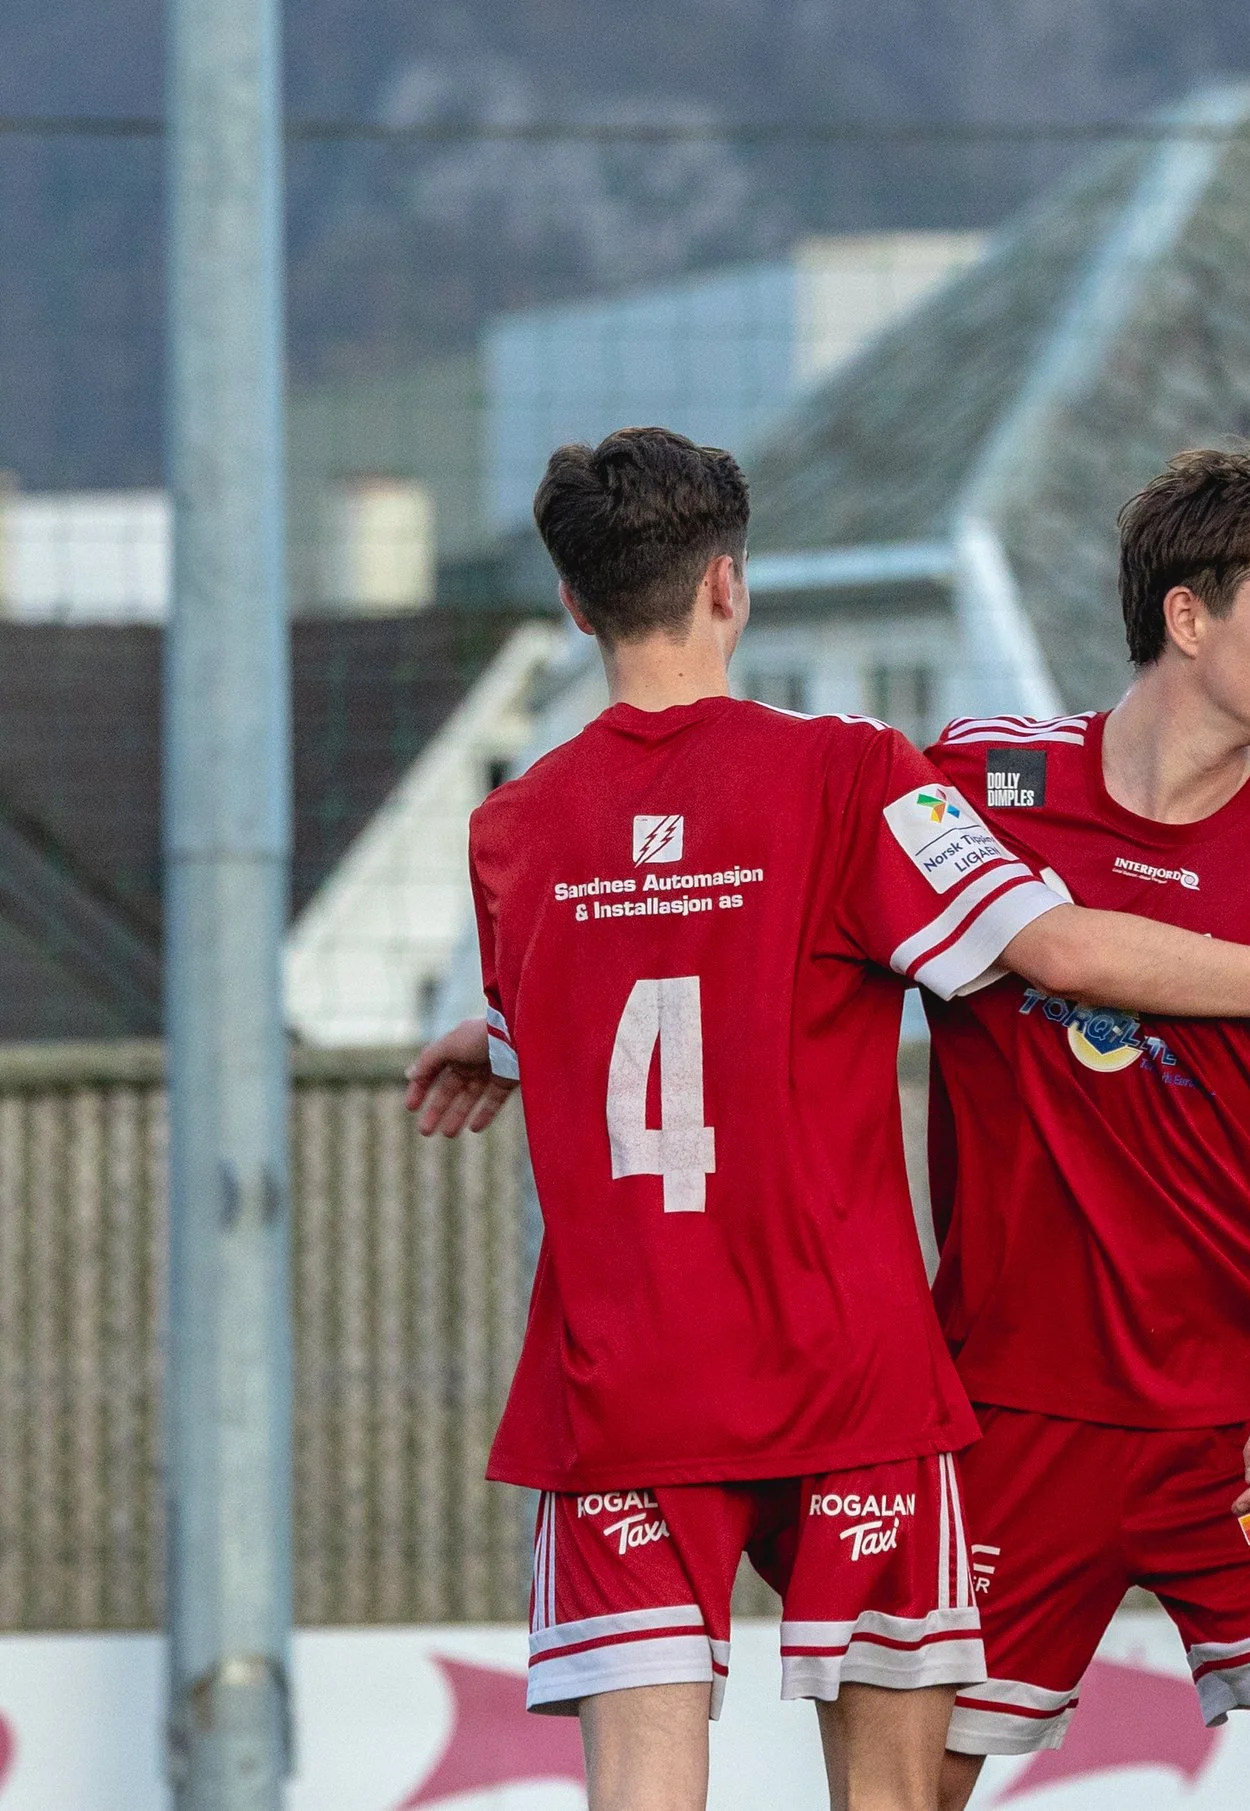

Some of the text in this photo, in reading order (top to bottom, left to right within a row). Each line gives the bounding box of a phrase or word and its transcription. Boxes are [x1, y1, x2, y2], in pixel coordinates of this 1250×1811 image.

[987, 772, 1020, 789] DOLLY
[987, 789, 1034, 807] DIMPLES
[923, 842, 963, 873] Norsk
[554, 866, 763, 901] Sandnes Automasjon
[575, 894, 743, 921] & Installasjon as
[606, 975, 716, 1214] 4
[577, 1488, 658, 1518] ROGAL
[809, 1493, 915, 1517] ROGALAN
[839, 1517, 900, 1562] Taxi
